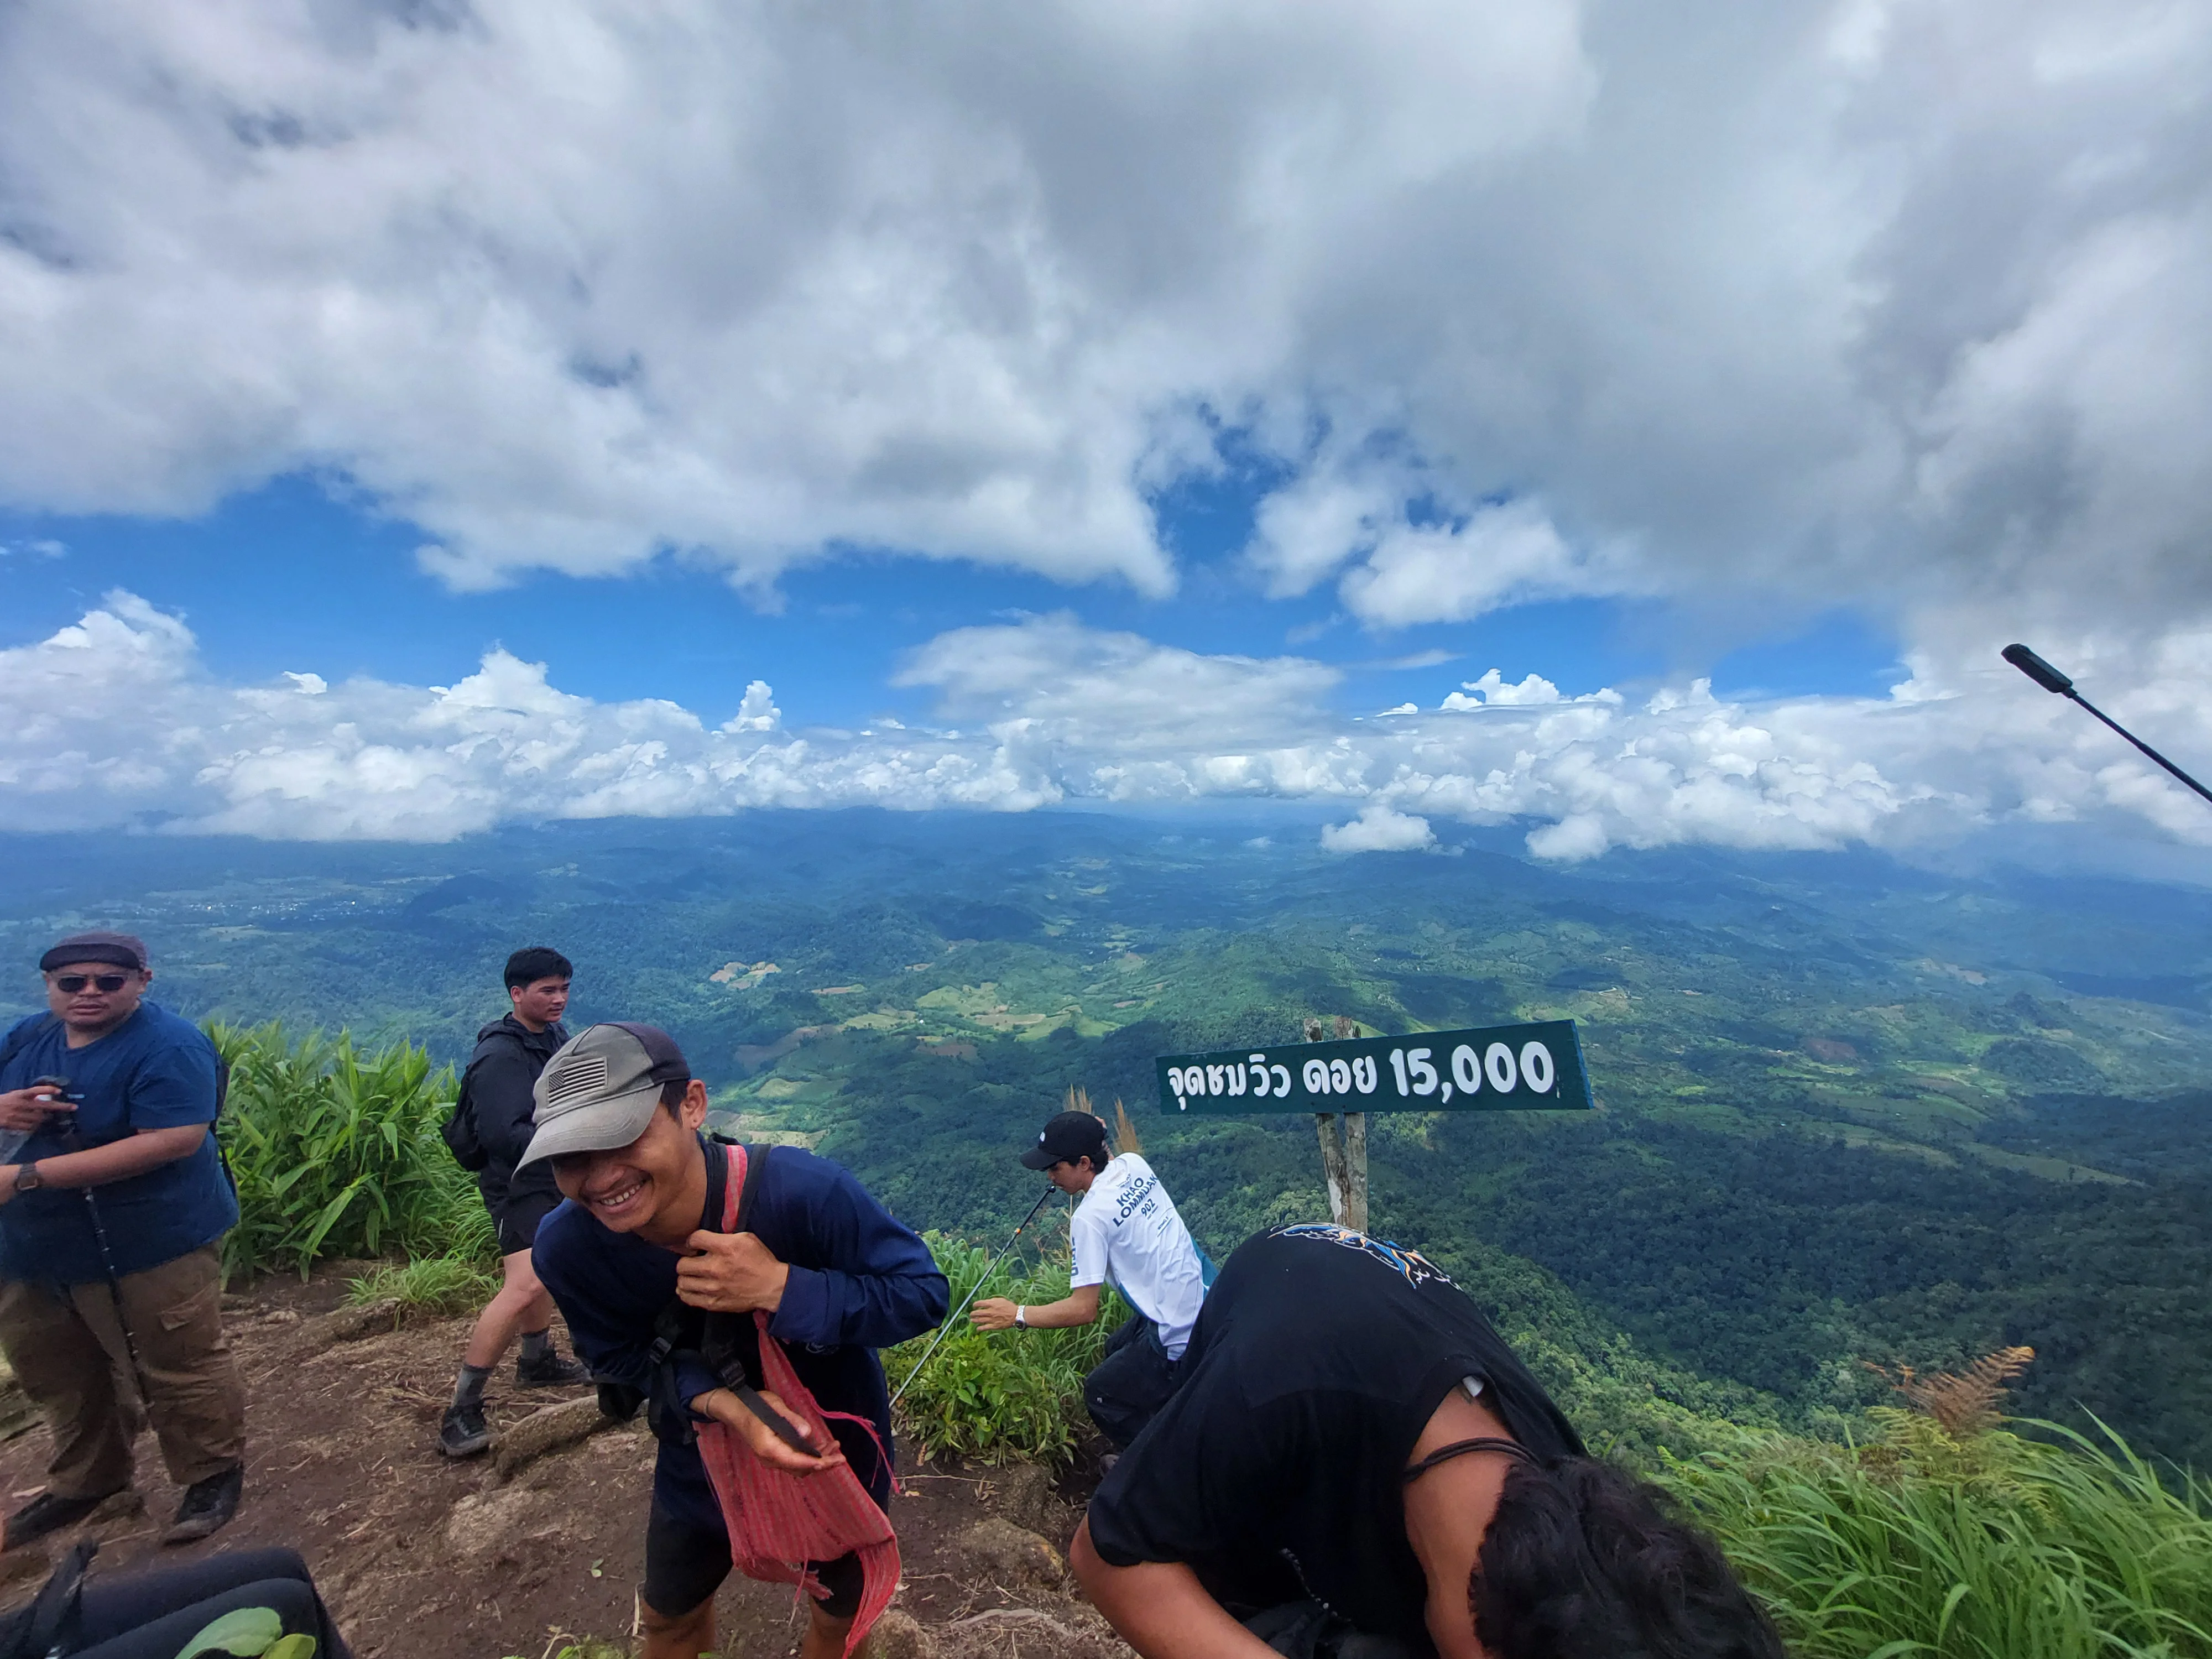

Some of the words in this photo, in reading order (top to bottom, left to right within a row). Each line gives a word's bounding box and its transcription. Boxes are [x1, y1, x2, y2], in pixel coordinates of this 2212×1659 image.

[1167, 1053, 1292, 1111] จุดชมวิว
[1302, 1055, 1378, 1095] ดอย
[1389, 1041, 1554, 1104] 15,000
[1112, 1173, 1159, 1228] LOMMUAK
[1116, 1177, 1144, 1207] KHAO
[1140, 1198, 1156, 1217] 902
